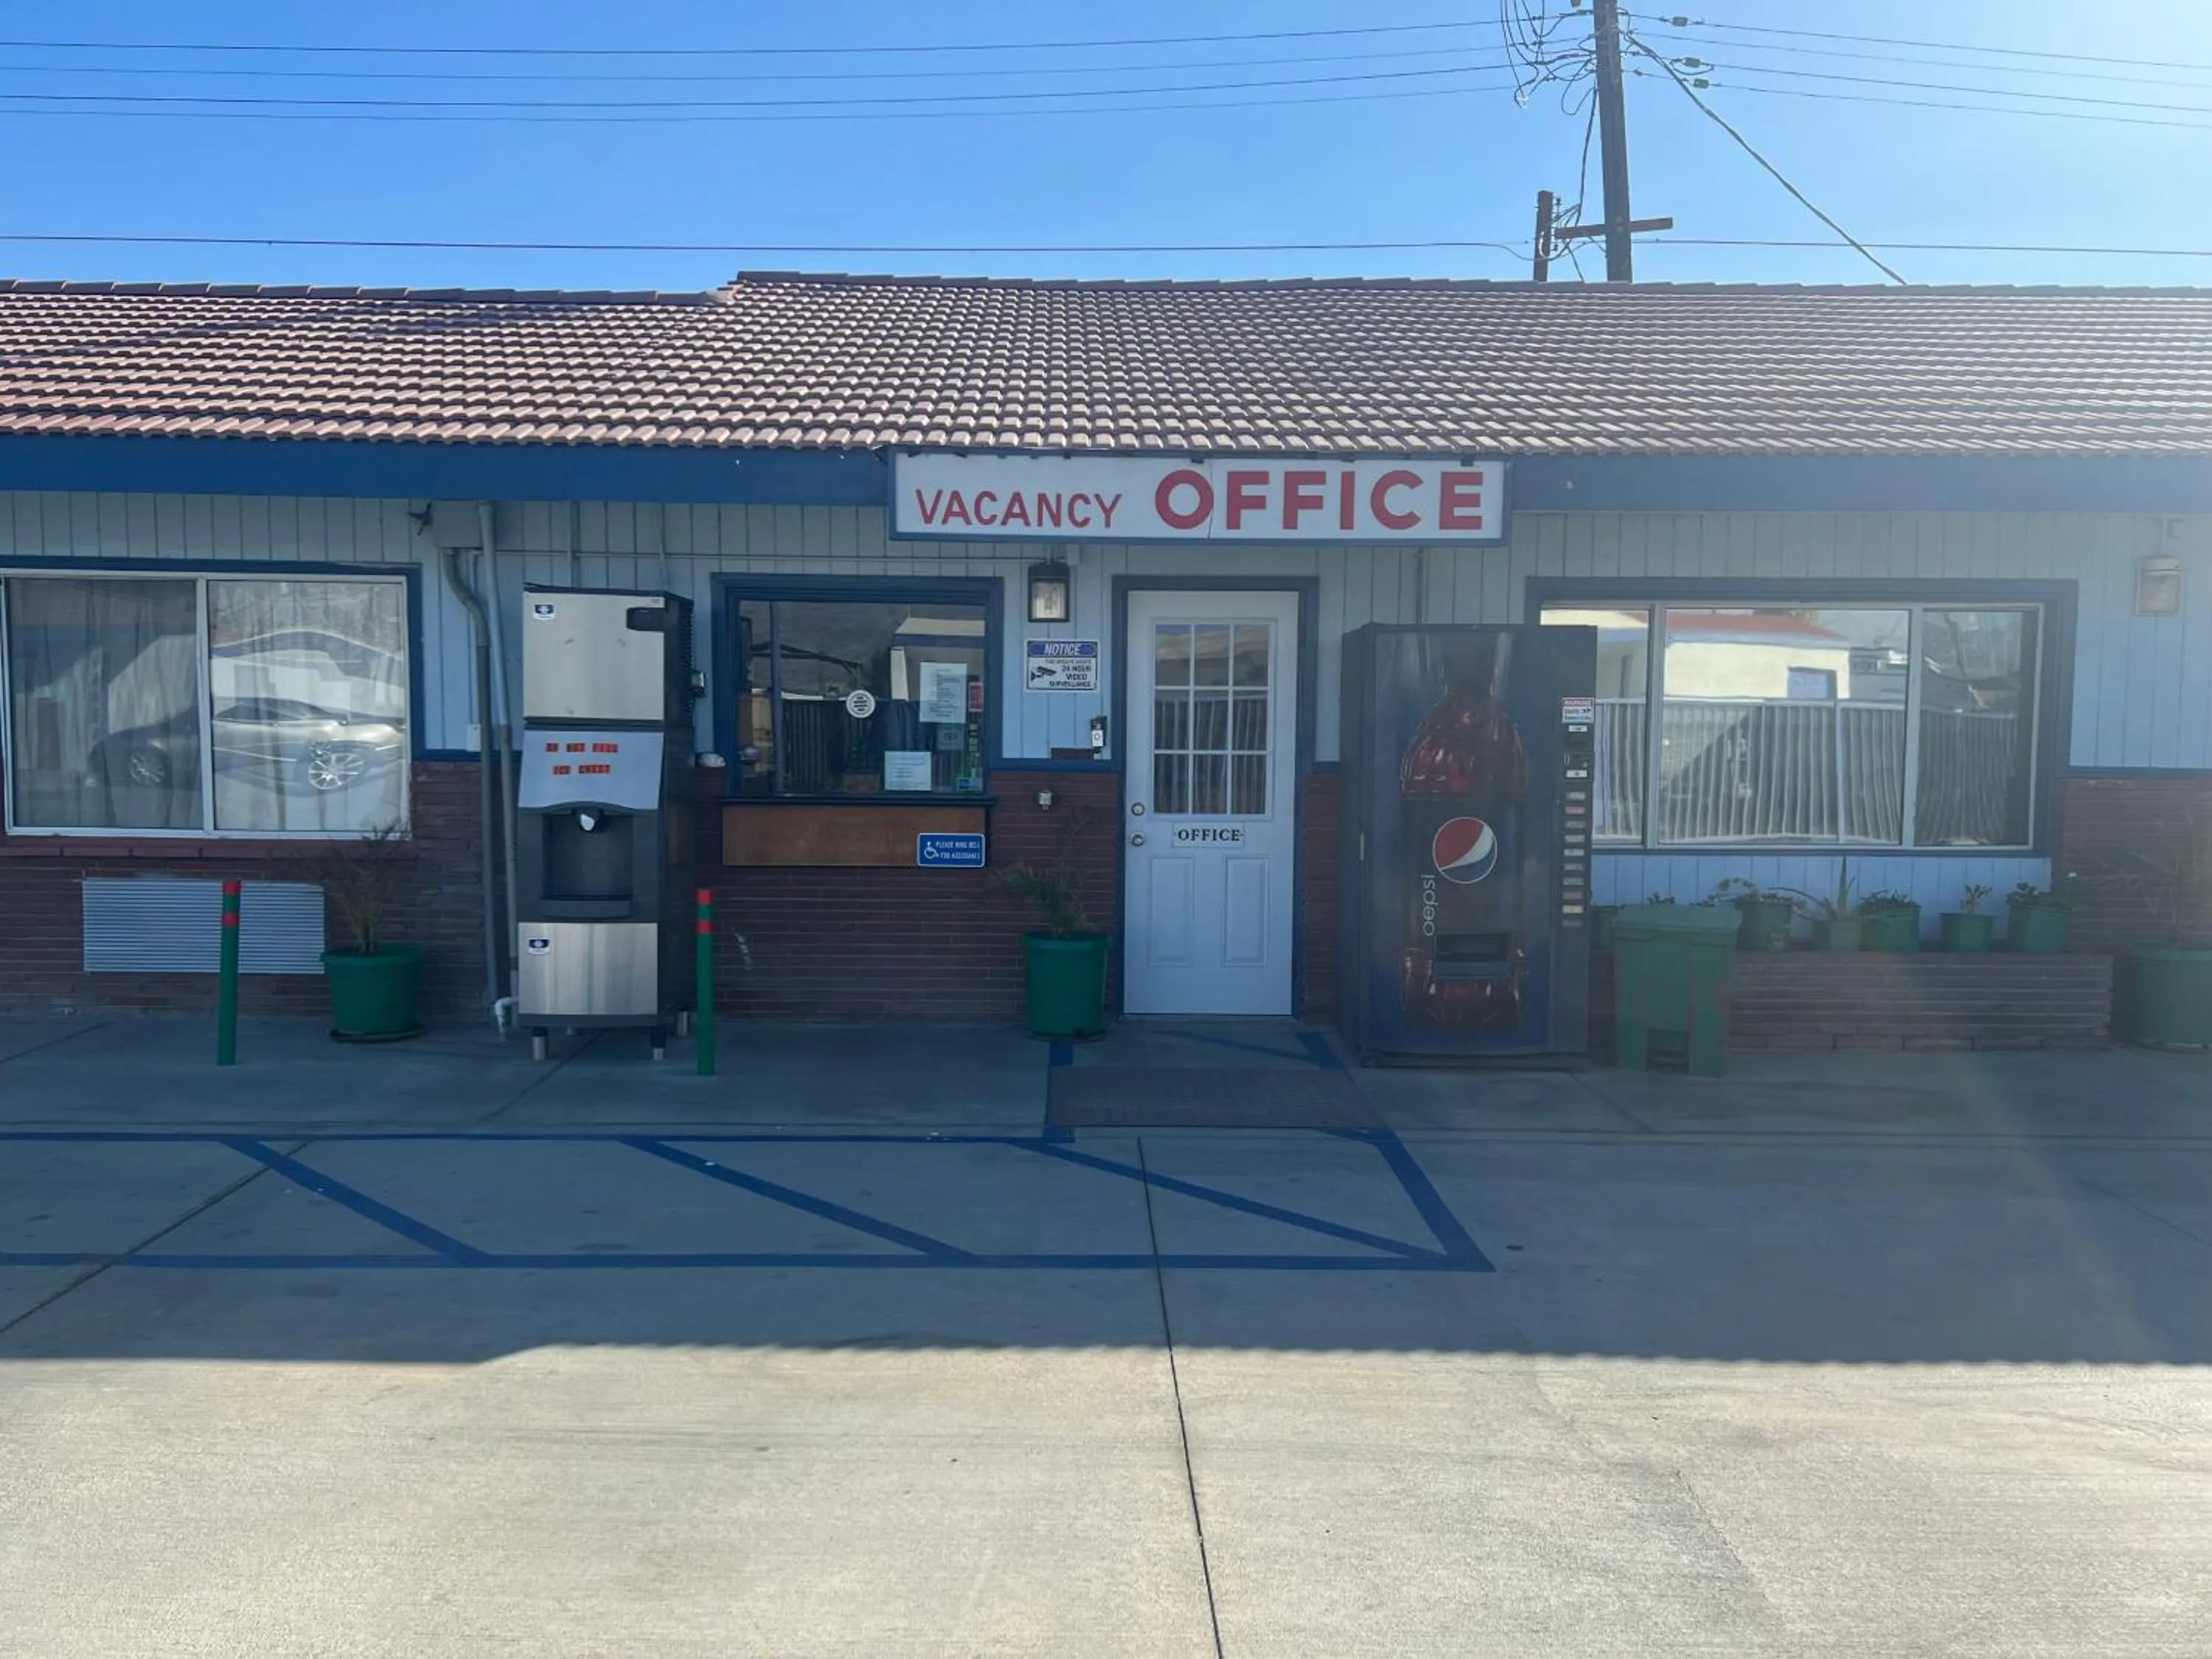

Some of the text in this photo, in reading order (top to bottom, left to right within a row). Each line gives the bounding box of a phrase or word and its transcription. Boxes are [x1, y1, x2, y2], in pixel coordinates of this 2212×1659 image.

[915, 469, 1484, 531] VACANCY OFFICE
[1044, 643, 1081, 655] NOTICE
[1178, 828, 1240, 841] OFFICE
